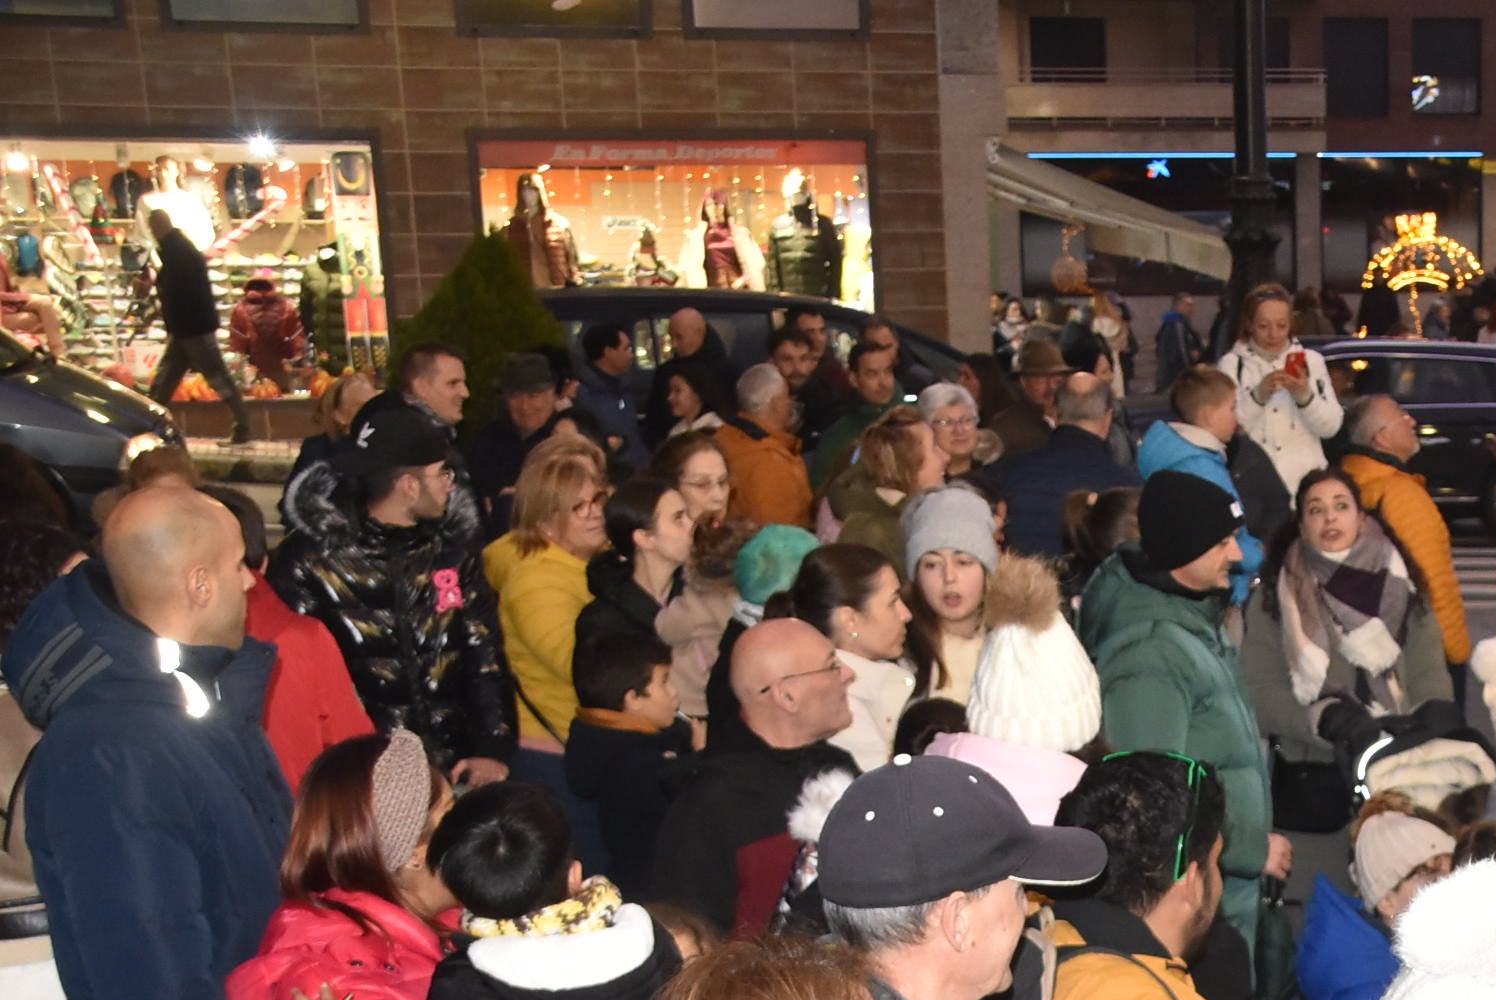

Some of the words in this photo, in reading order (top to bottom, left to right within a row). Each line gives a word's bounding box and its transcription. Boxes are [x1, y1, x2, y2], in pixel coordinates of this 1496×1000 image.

[550, 145, 586, 161] En
[589, 145, 668, 161] Forma
[671, 145, 778, 162] Deportes
